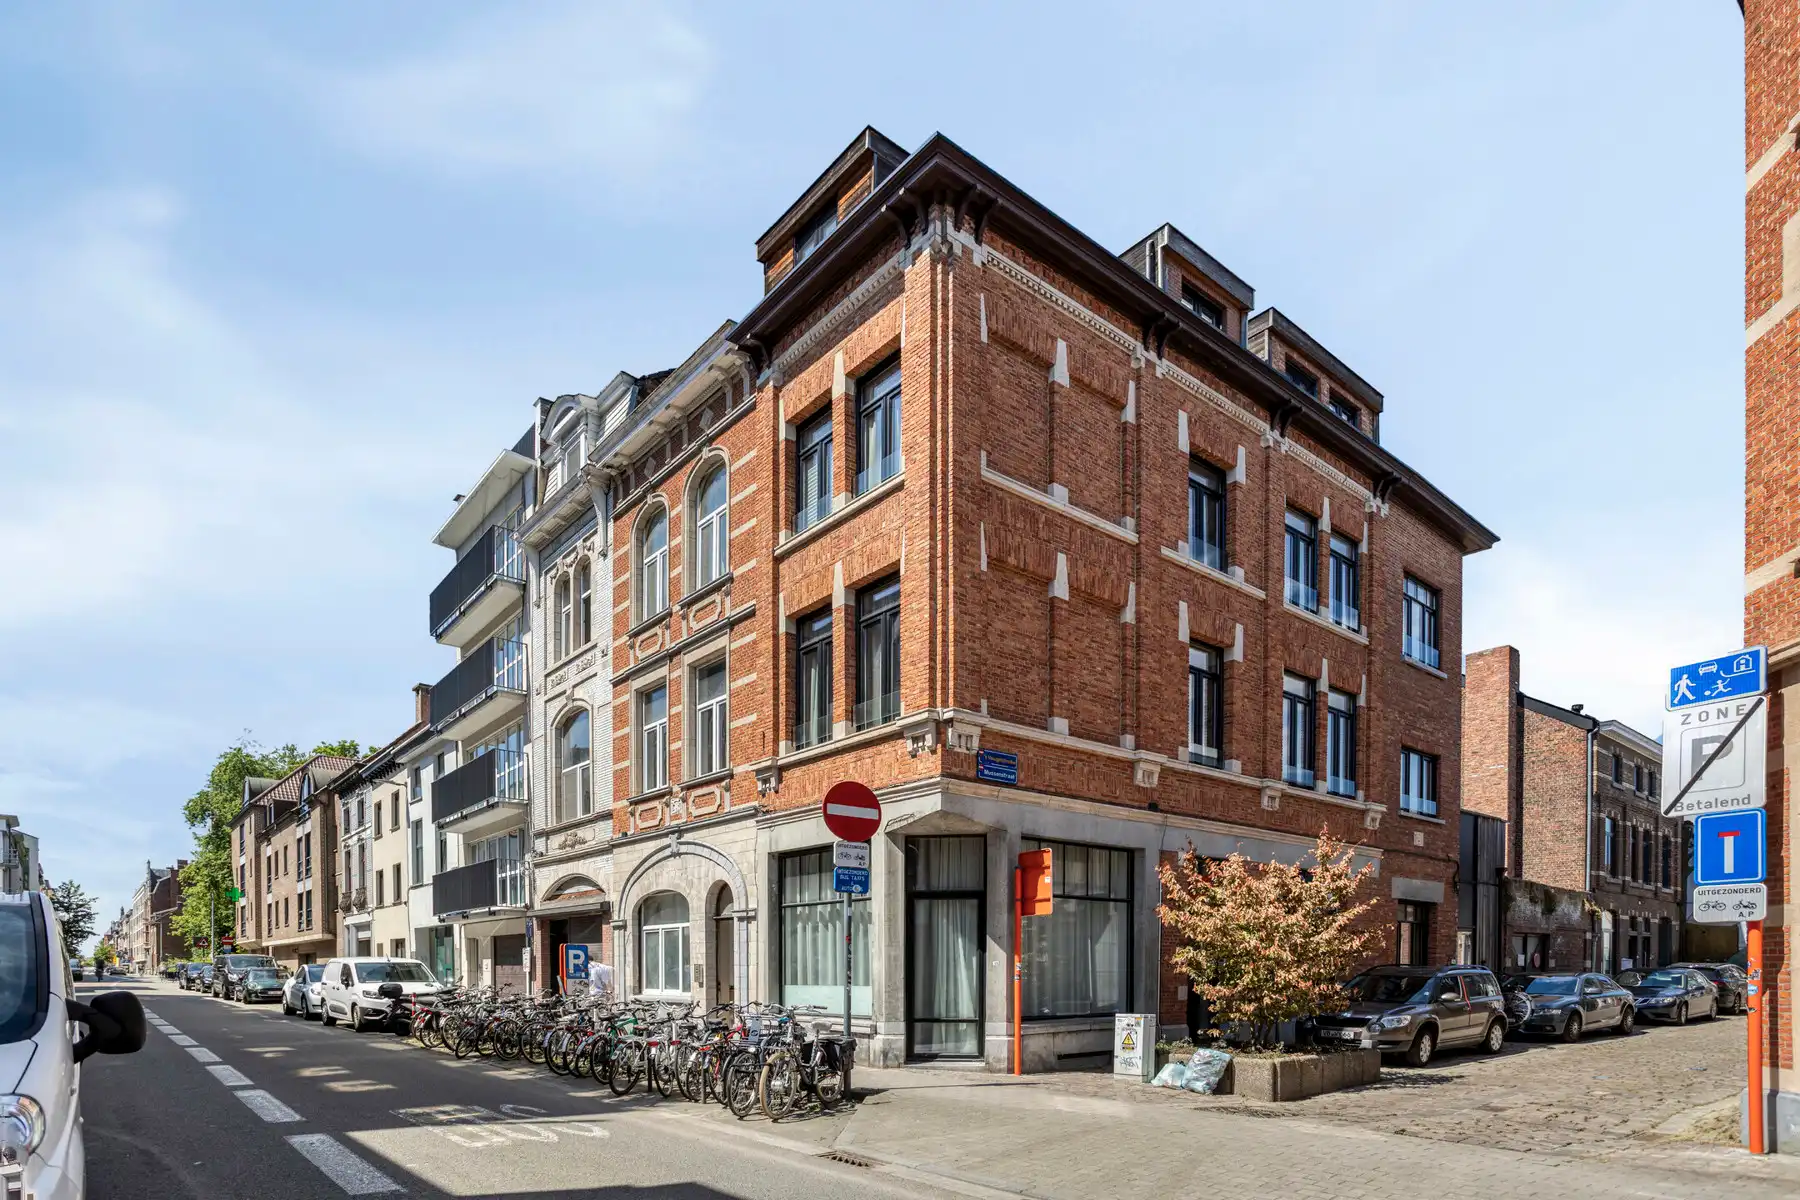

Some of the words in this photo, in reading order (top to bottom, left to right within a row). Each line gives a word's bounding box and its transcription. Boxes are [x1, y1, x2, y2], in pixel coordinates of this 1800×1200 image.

[1680, 703, 1747, 726] ZONE
[1690, 734, 1734, 781] P
[1673, 793, 1752, 813] Betalend
[1697, 887, 1762, 896] UITGEZONDERD
[1747, 910, 1755, 918] P
[568, 949, 585, 973] P
